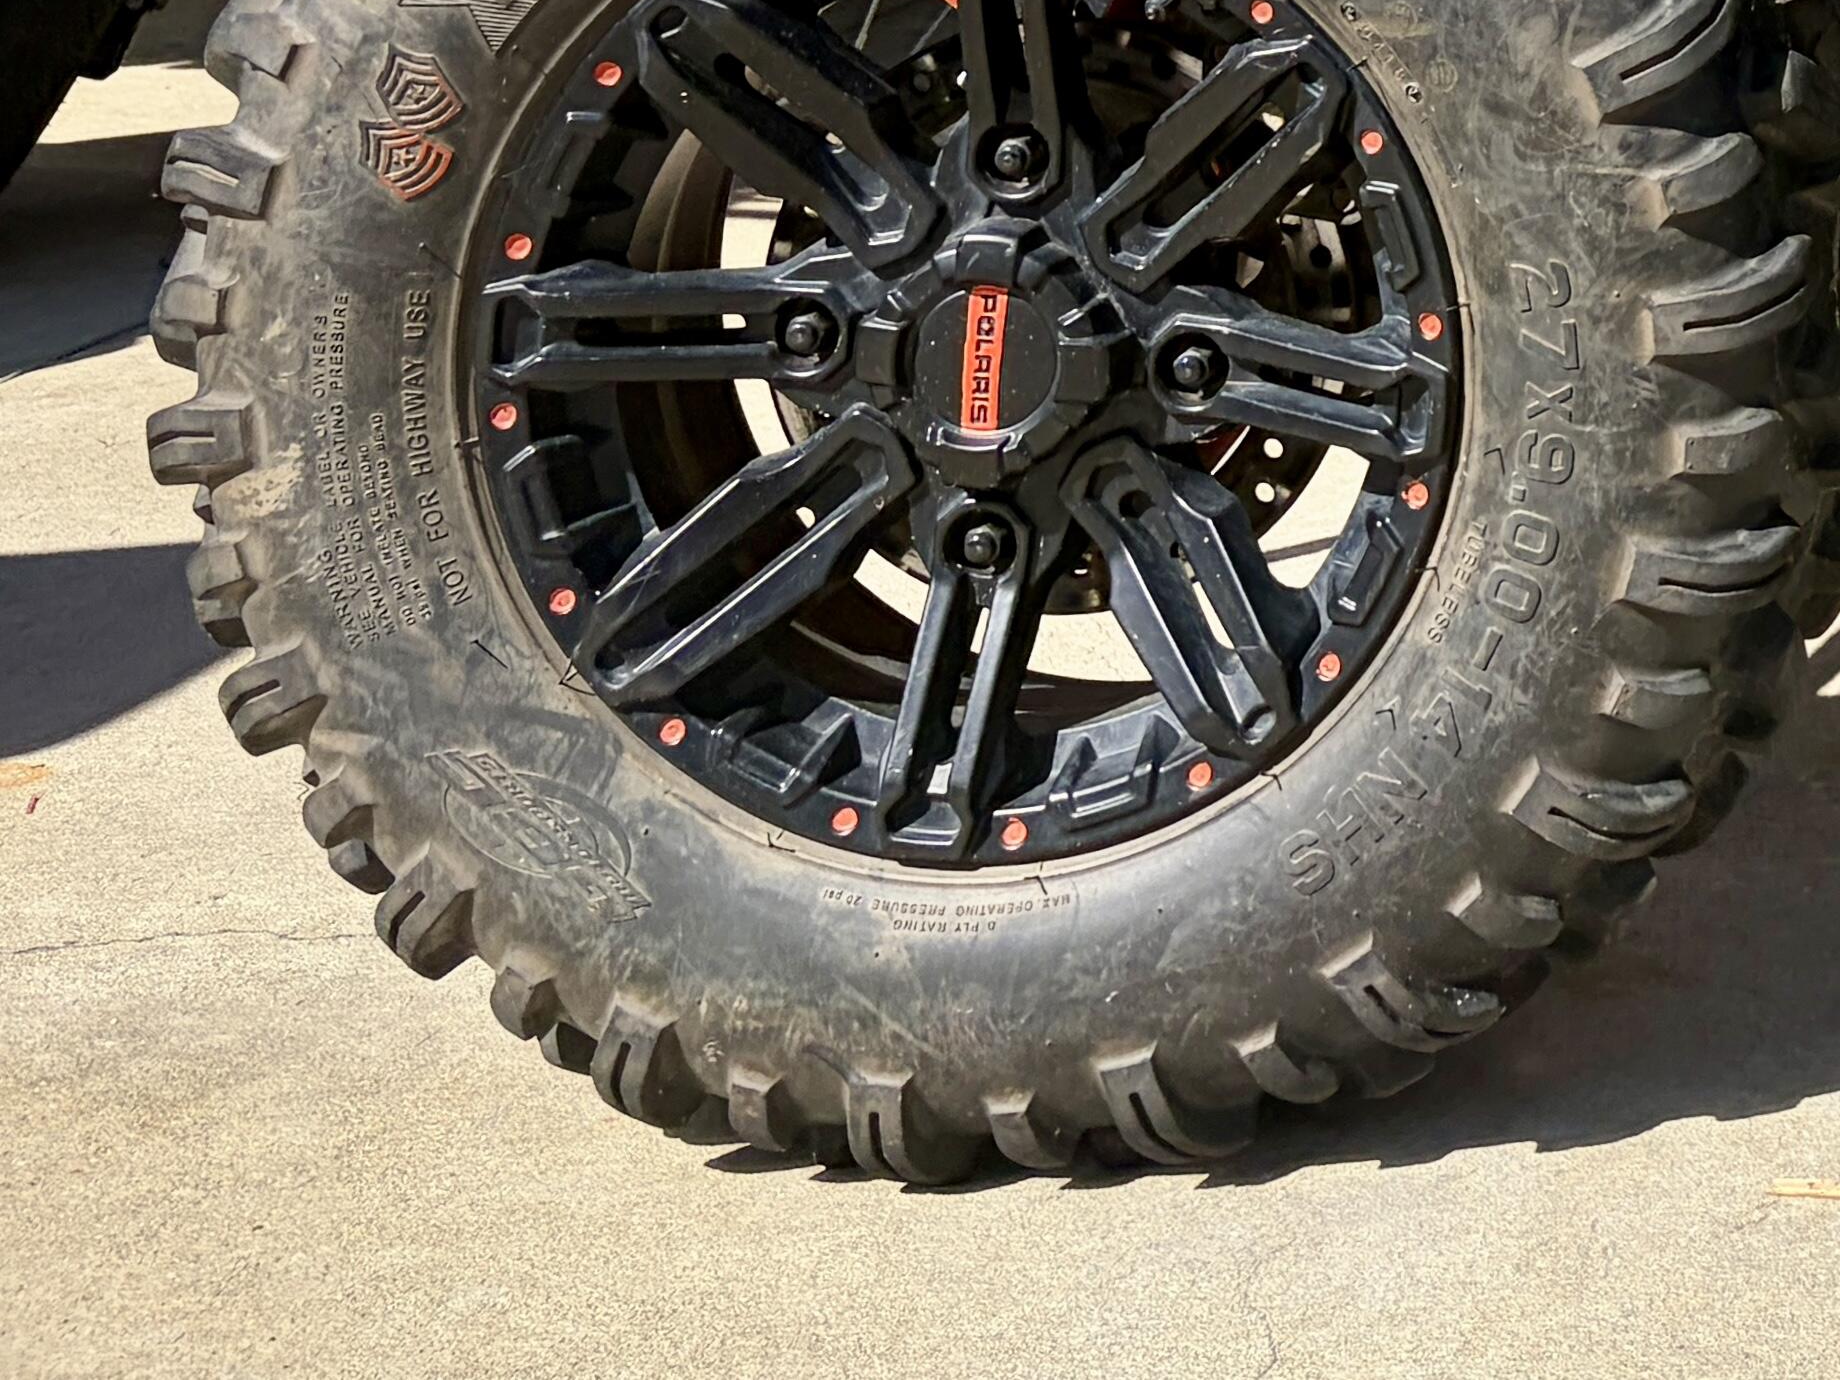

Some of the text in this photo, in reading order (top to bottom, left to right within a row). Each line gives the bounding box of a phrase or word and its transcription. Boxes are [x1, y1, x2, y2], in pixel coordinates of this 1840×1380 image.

[970, 294, 997, 425] POLARIS
[311, 410, 328, 439] OR
[400, 285, 473, 607] NOT FOR HIGHWAY USE
[315, 449, 339, 509] LABEL
[328, 403, 357, 508] OPERATING
[375, 458, 399, 520] SEATING
[327, 520, 364, 599] VEHICLE
[345, 516, 368, 554] FOR
[390, 526, 414, 570] WHEN
[358, 562, 398, 637] MANUAL
[1427, 521, 1487, 644] TUBELESS
[356, 607, 382, 644] SEE
[1283, 747, 1428, 897] NHS
[870, 896, 947, 918] PRESSURE
[891, 916, 947, 934] RATING
[953, 920, 979, 933] PLY
[954, 899, 1034, 917] OPERATING
